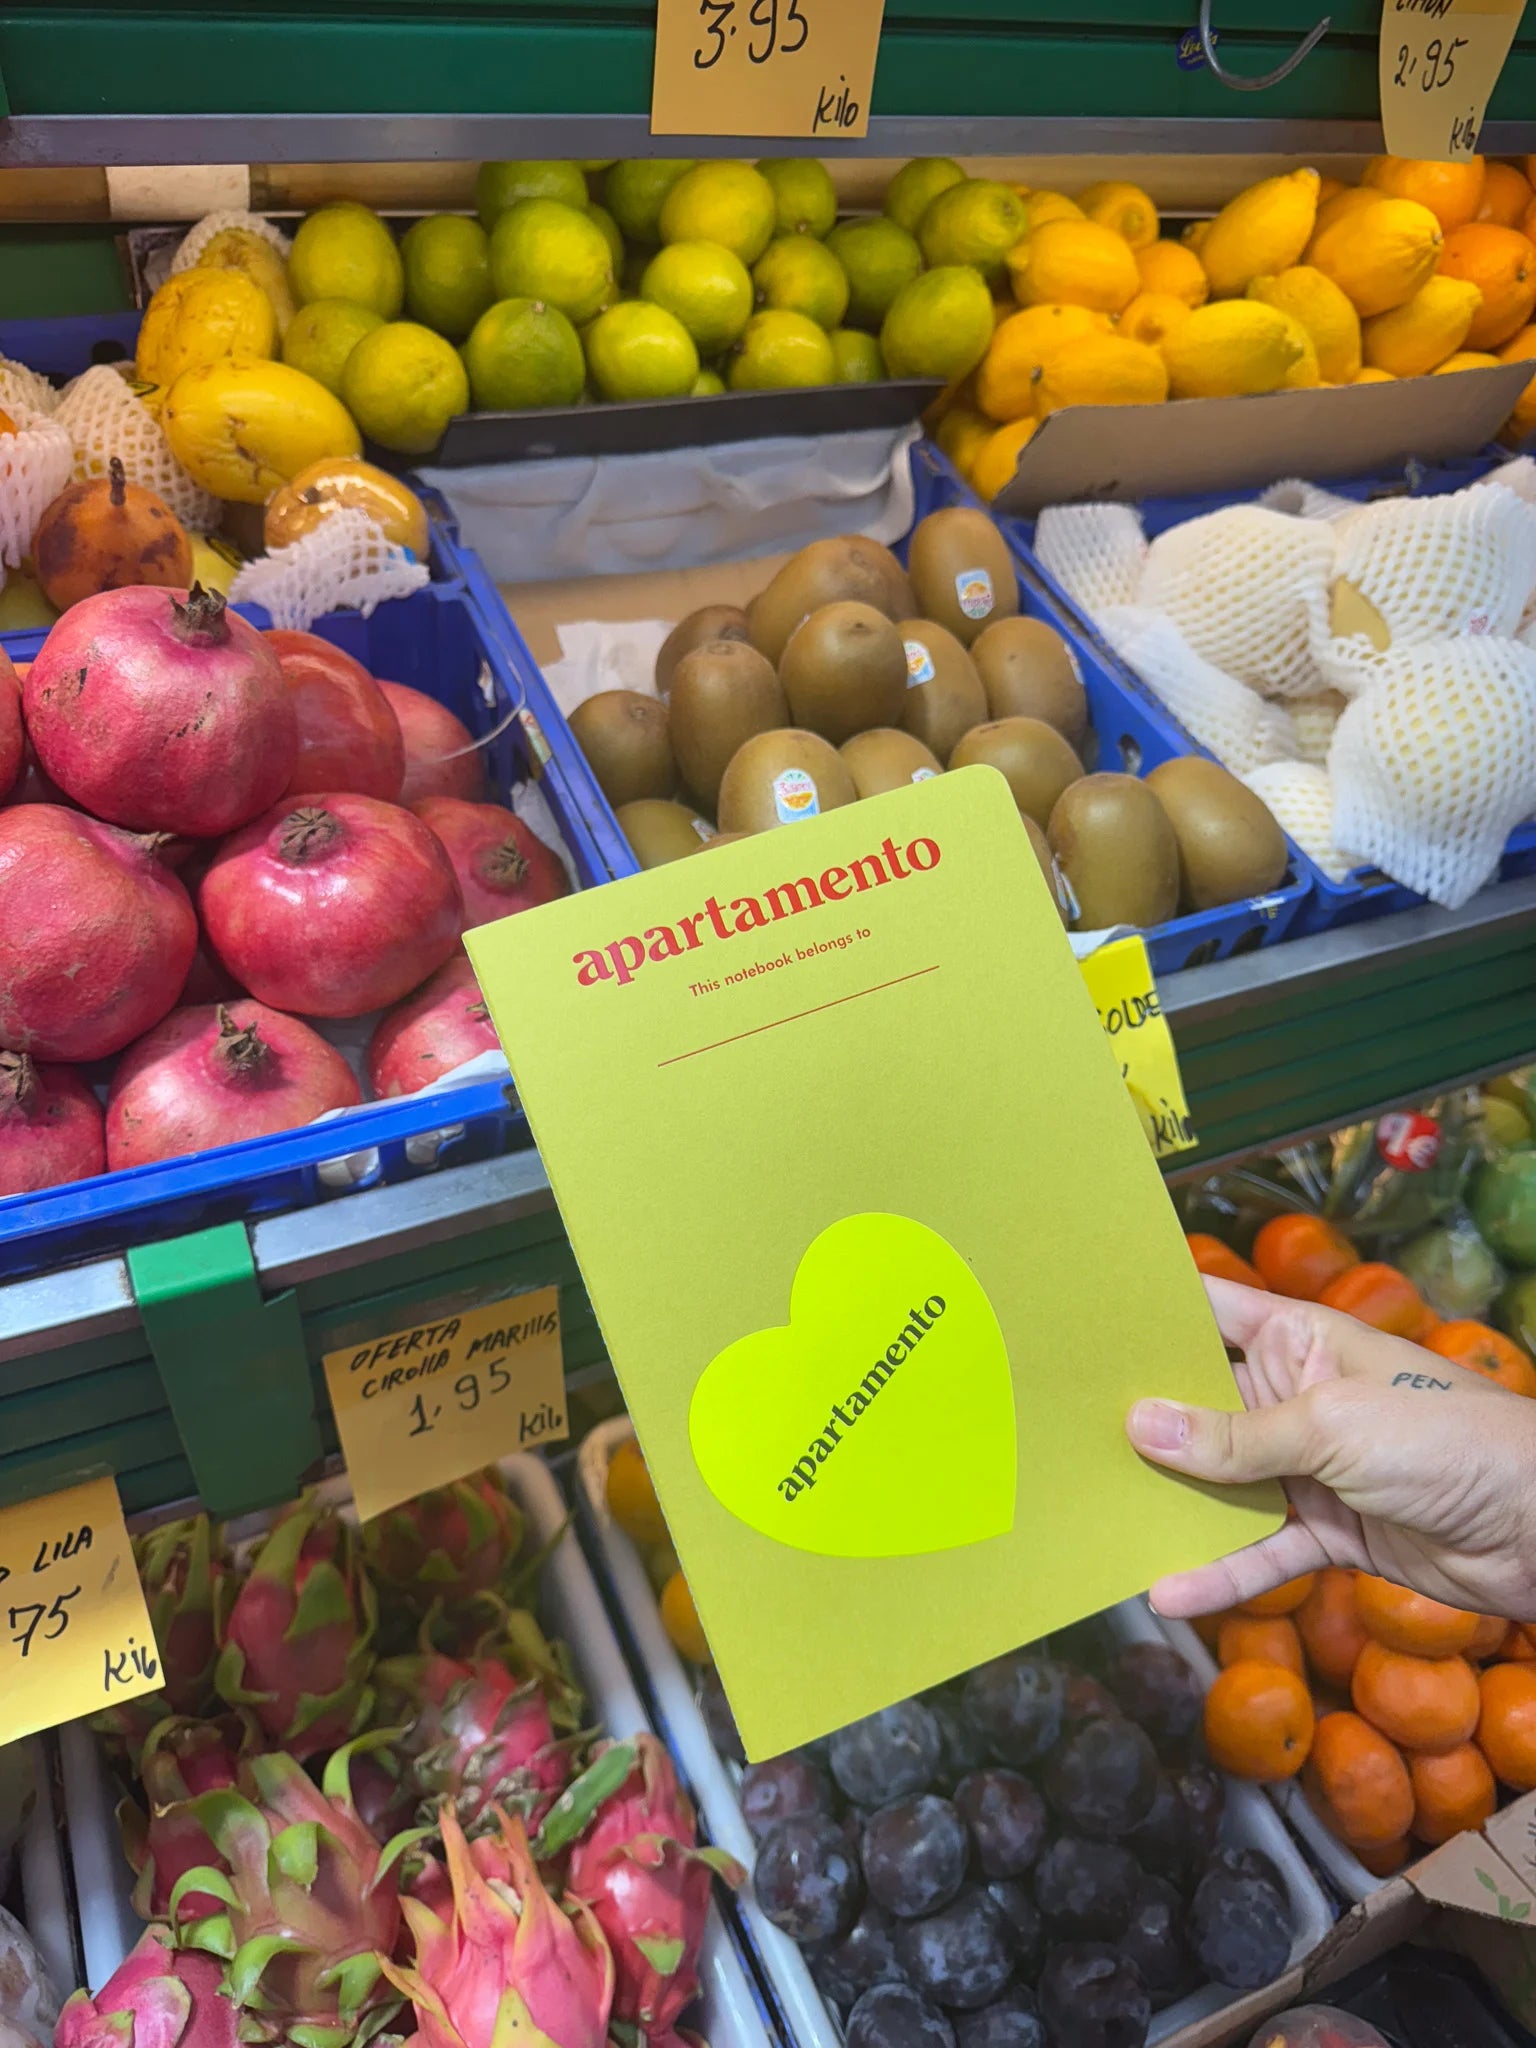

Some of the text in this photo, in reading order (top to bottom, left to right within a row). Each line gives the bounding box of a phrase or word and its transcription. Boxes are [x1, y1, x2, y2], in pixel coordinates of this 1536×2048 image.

[571, 837, 942, 986] apartamento
[688, 928, 871, 998] This notebook belongs to
[351, 1318, 462, 1371] OFERTA
[777, 1295, 946, 1502] apartamento
[1391, 1372, 1452, 1390] PEN
[33, 1525, 93, 1573] LILA
